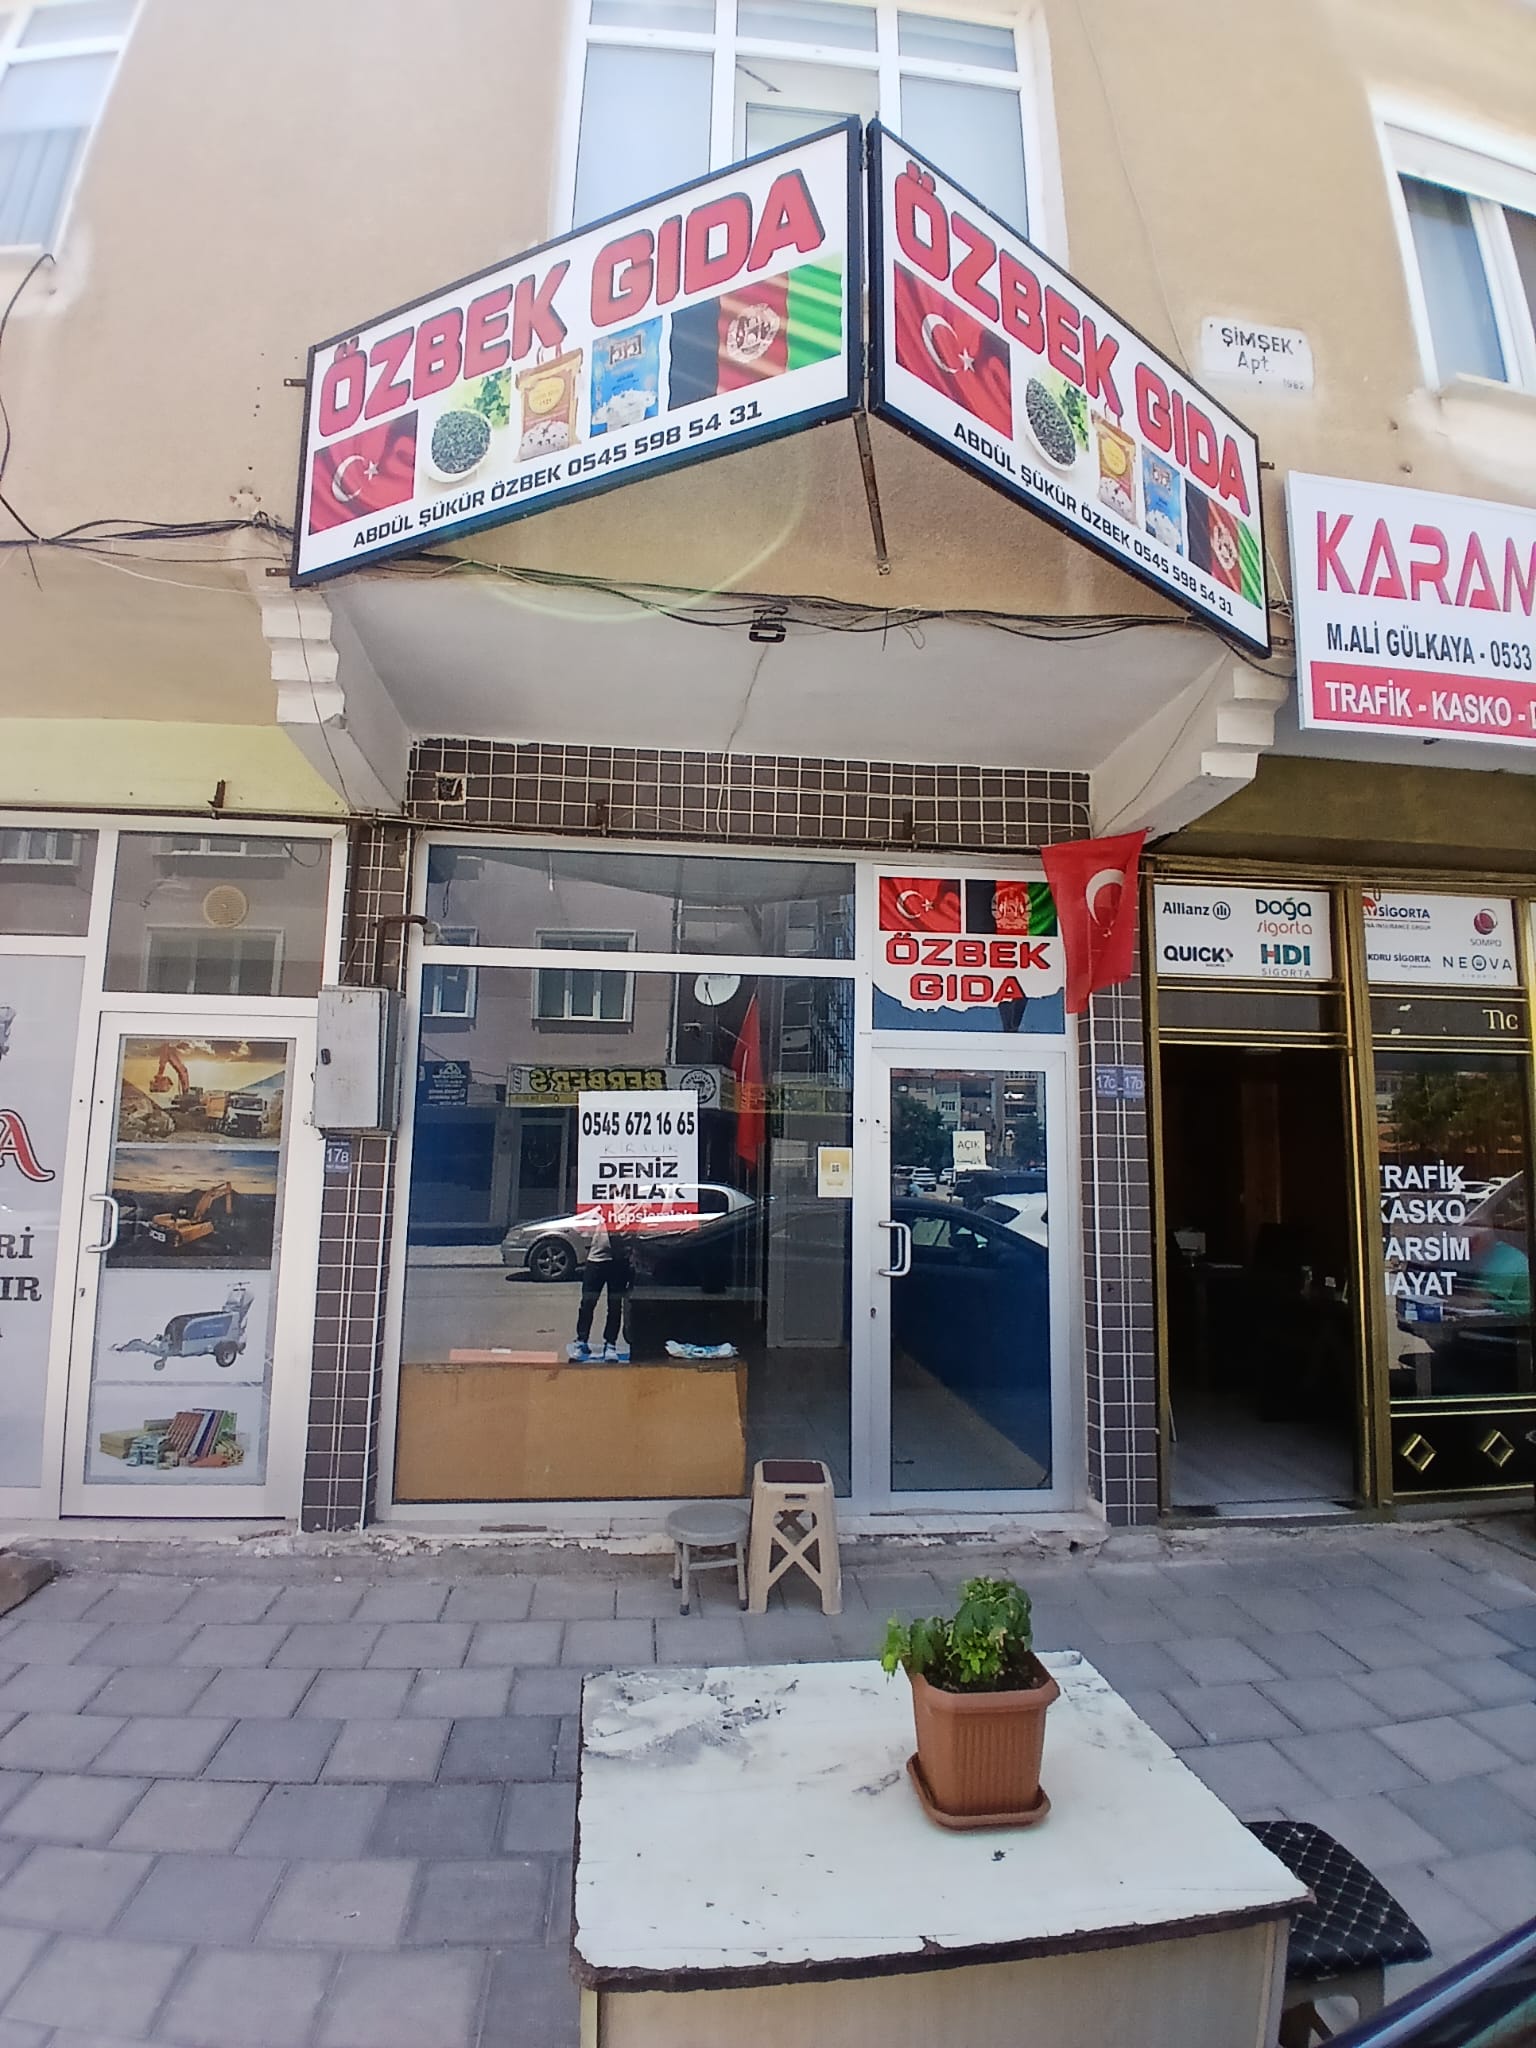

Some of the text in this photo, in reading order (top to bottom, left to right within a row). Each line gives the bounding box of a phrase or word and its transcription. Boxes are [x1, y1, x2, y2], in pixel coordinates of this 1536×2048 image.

[318, 168, 826, 437] ÖZBEK GIDA
[895, 160, 1250, 517] ÖZBEK GIDA
[1221, 326, 1294, 355] ŞİMŞEK
[353, 401, 763, 548] ABDÜL ŞÜKÜR ÖZBEK 0545 598 54 31
[954, 422, 1234, 616] ABDÜL ŞÜKÜR ÖZBEK 0545 598 54 31
[1327, 621, 1380, 654] M.ALİ
[1386, 625, 1475, 664] GÜLKAYA
[1490, 640, 1532, 671] 0533
[1325, 679, 1414, 718] TRAFİK
[1418, 704, 1426, 712] -
[1432, 690, 1512, 727] KASKO
[1163, 902, 1210, 916] Allianz
[1379, 904, 1431, 919] SİGORTA
[1257, 920, 1313, 936] sigorta
[1470, 938, 1502, 947] SOMPO
[886, 932, 1051, 969] ÖZBEK
[1164, 945, 1225, 963] QUICK
[1261, 944, 1311, 966] HDI
[1442, 954, 1512, 971] NEOVA
[910, 974, 1027, 1003] GIDA
[582, 1111, 695, 1136] 0545 672 16 65
[326, 1148, 349, 1163] 17B
[599, 1156, 679, 1178] DENİZ
[1379, 1160, 1466, 1189] RAFİK
[1382, 1231, 1470, 1261] ARSİM
